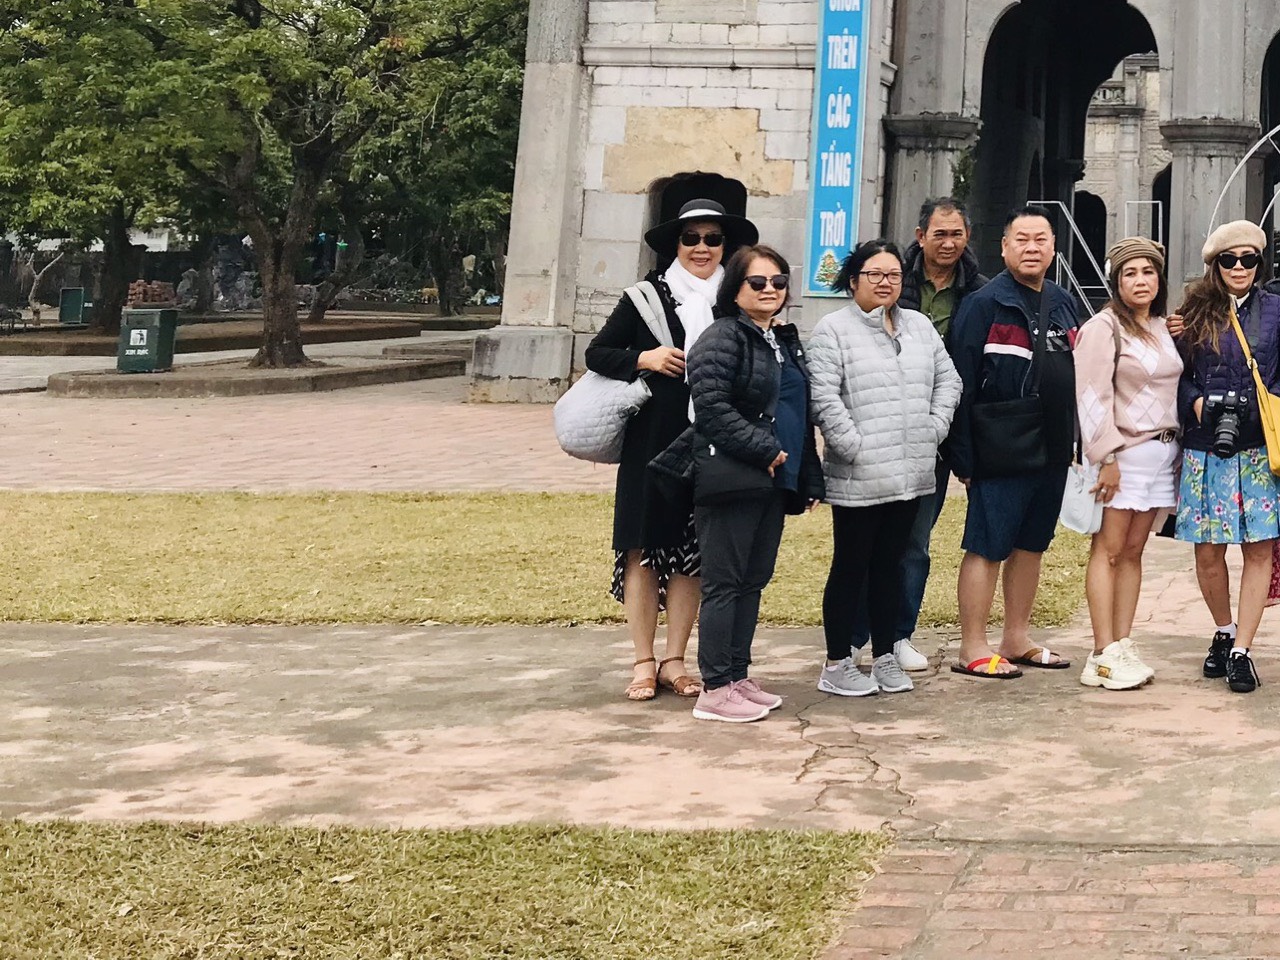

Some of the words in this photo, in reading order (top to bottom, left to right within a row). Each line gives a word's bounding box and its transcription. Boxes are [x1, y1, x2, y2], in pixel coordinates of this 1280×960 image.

[827, 28, 857, 69] TRÊN
[827, 86, 851, 128] CÁC
[819, 203, 846, 247] TRỜI
